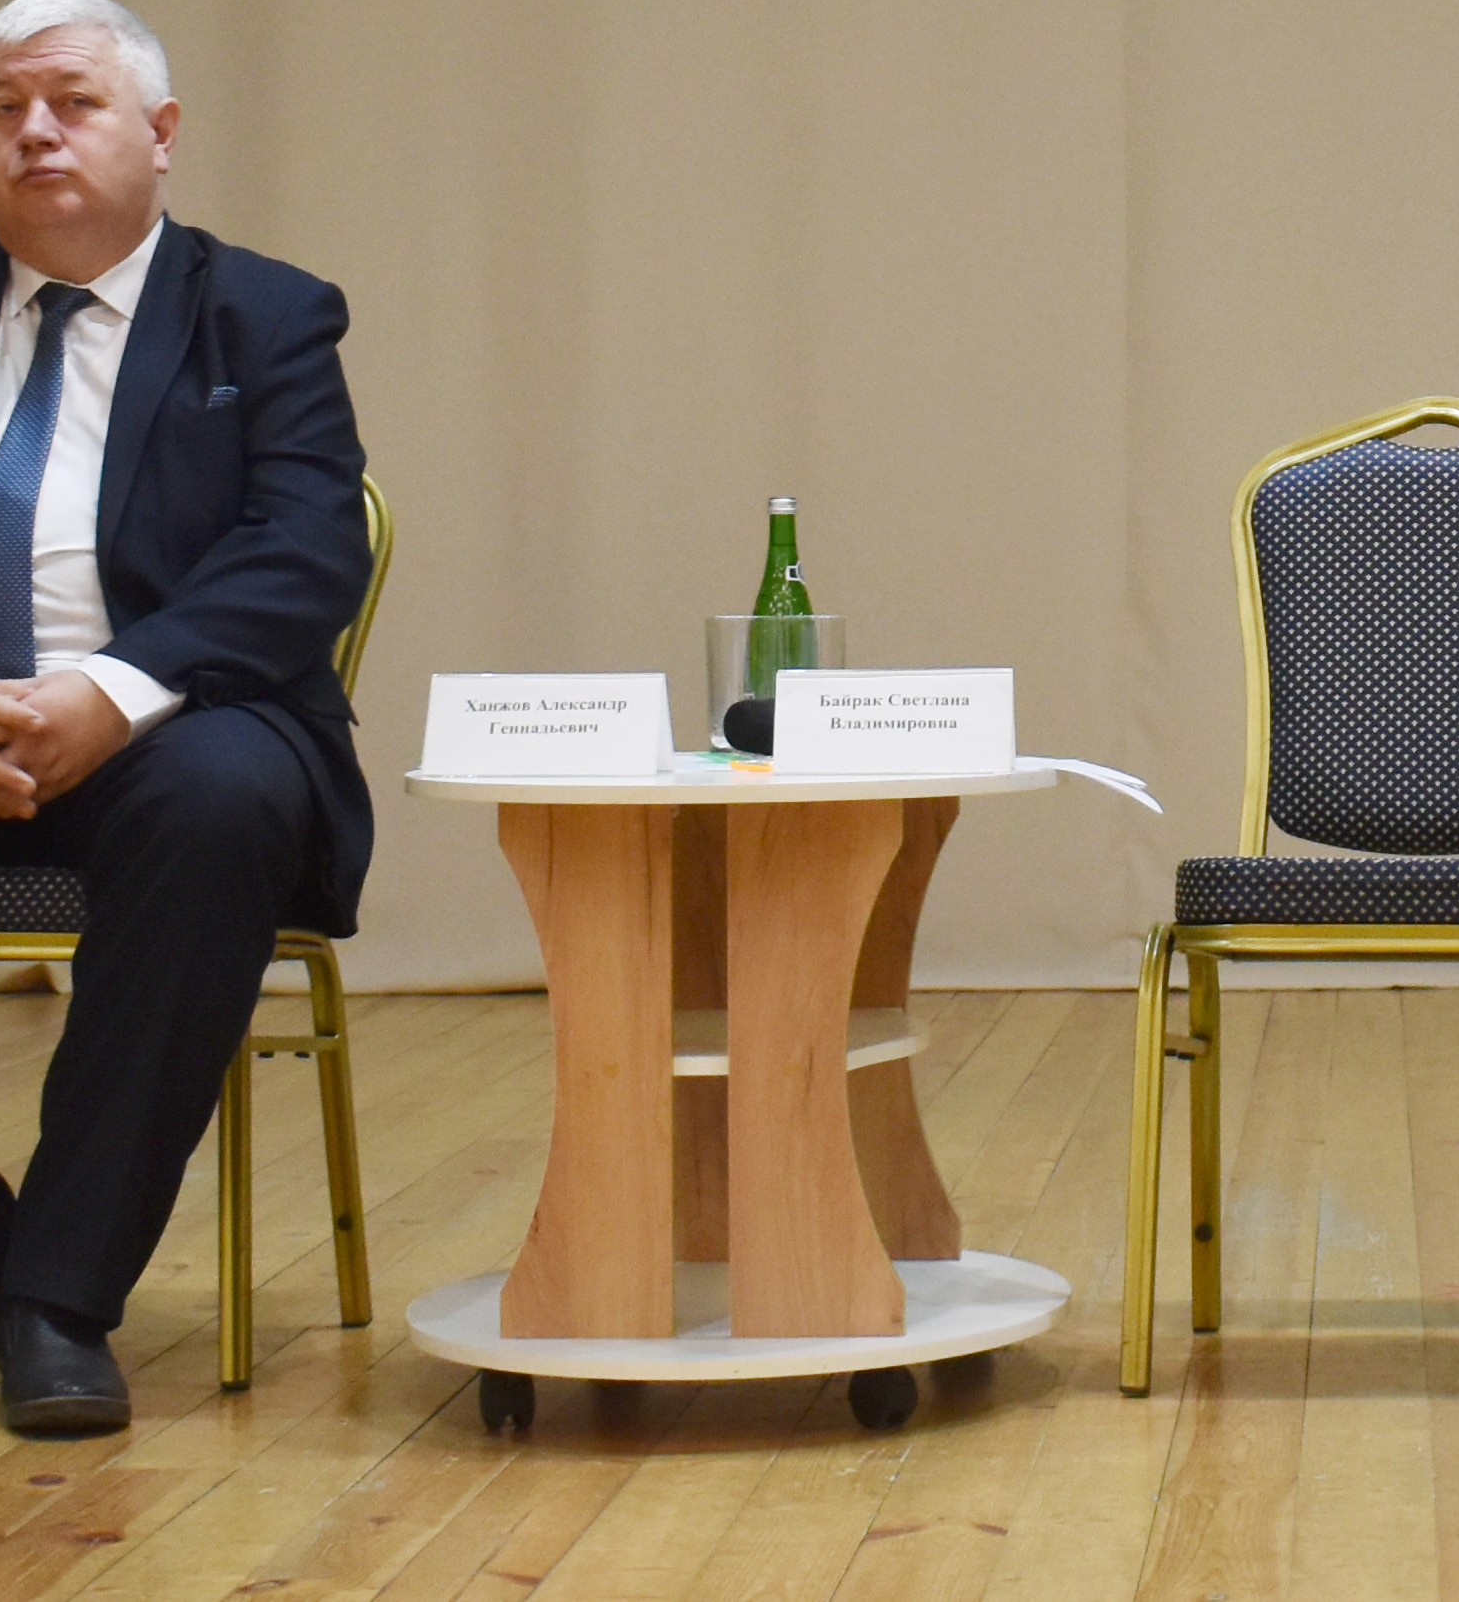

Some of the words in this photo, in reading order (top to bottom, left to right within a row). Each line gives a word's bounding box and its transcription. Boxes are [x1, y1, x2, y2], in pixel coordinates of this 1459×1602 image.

[465, 699, 531, 713] Ханжов
[536, 698, 627, 714] Александр
[820, 694, 883, 710] Байрак
[888, 693, 970, 707] Светлана
[489, 721, 599, 735] Геннадьевич
[830, 717, 958, 732] Владимировна
